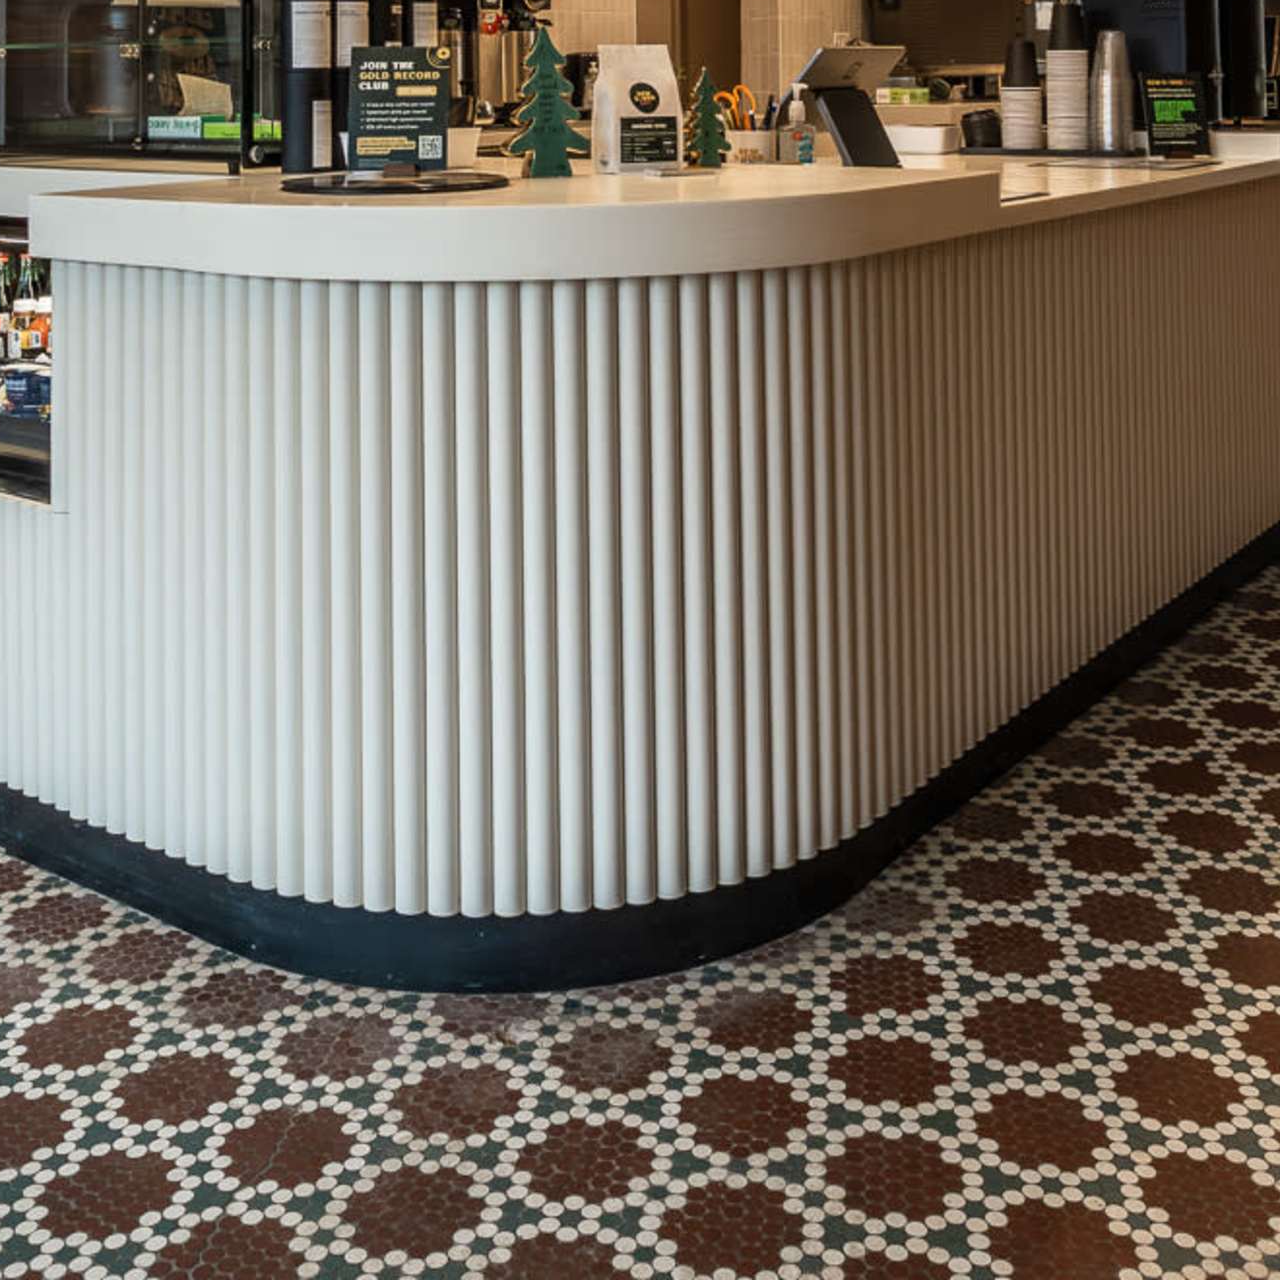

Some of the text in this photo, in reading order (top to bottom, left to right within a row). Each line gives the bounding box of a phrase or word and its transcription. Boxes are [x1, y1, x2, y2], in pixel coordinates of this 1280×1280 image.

[359, 61, 414, 70] JOIN THE
[359, 71, 441, 80] GOLD RECORD
[358, 81, 389, 91] CLUB
